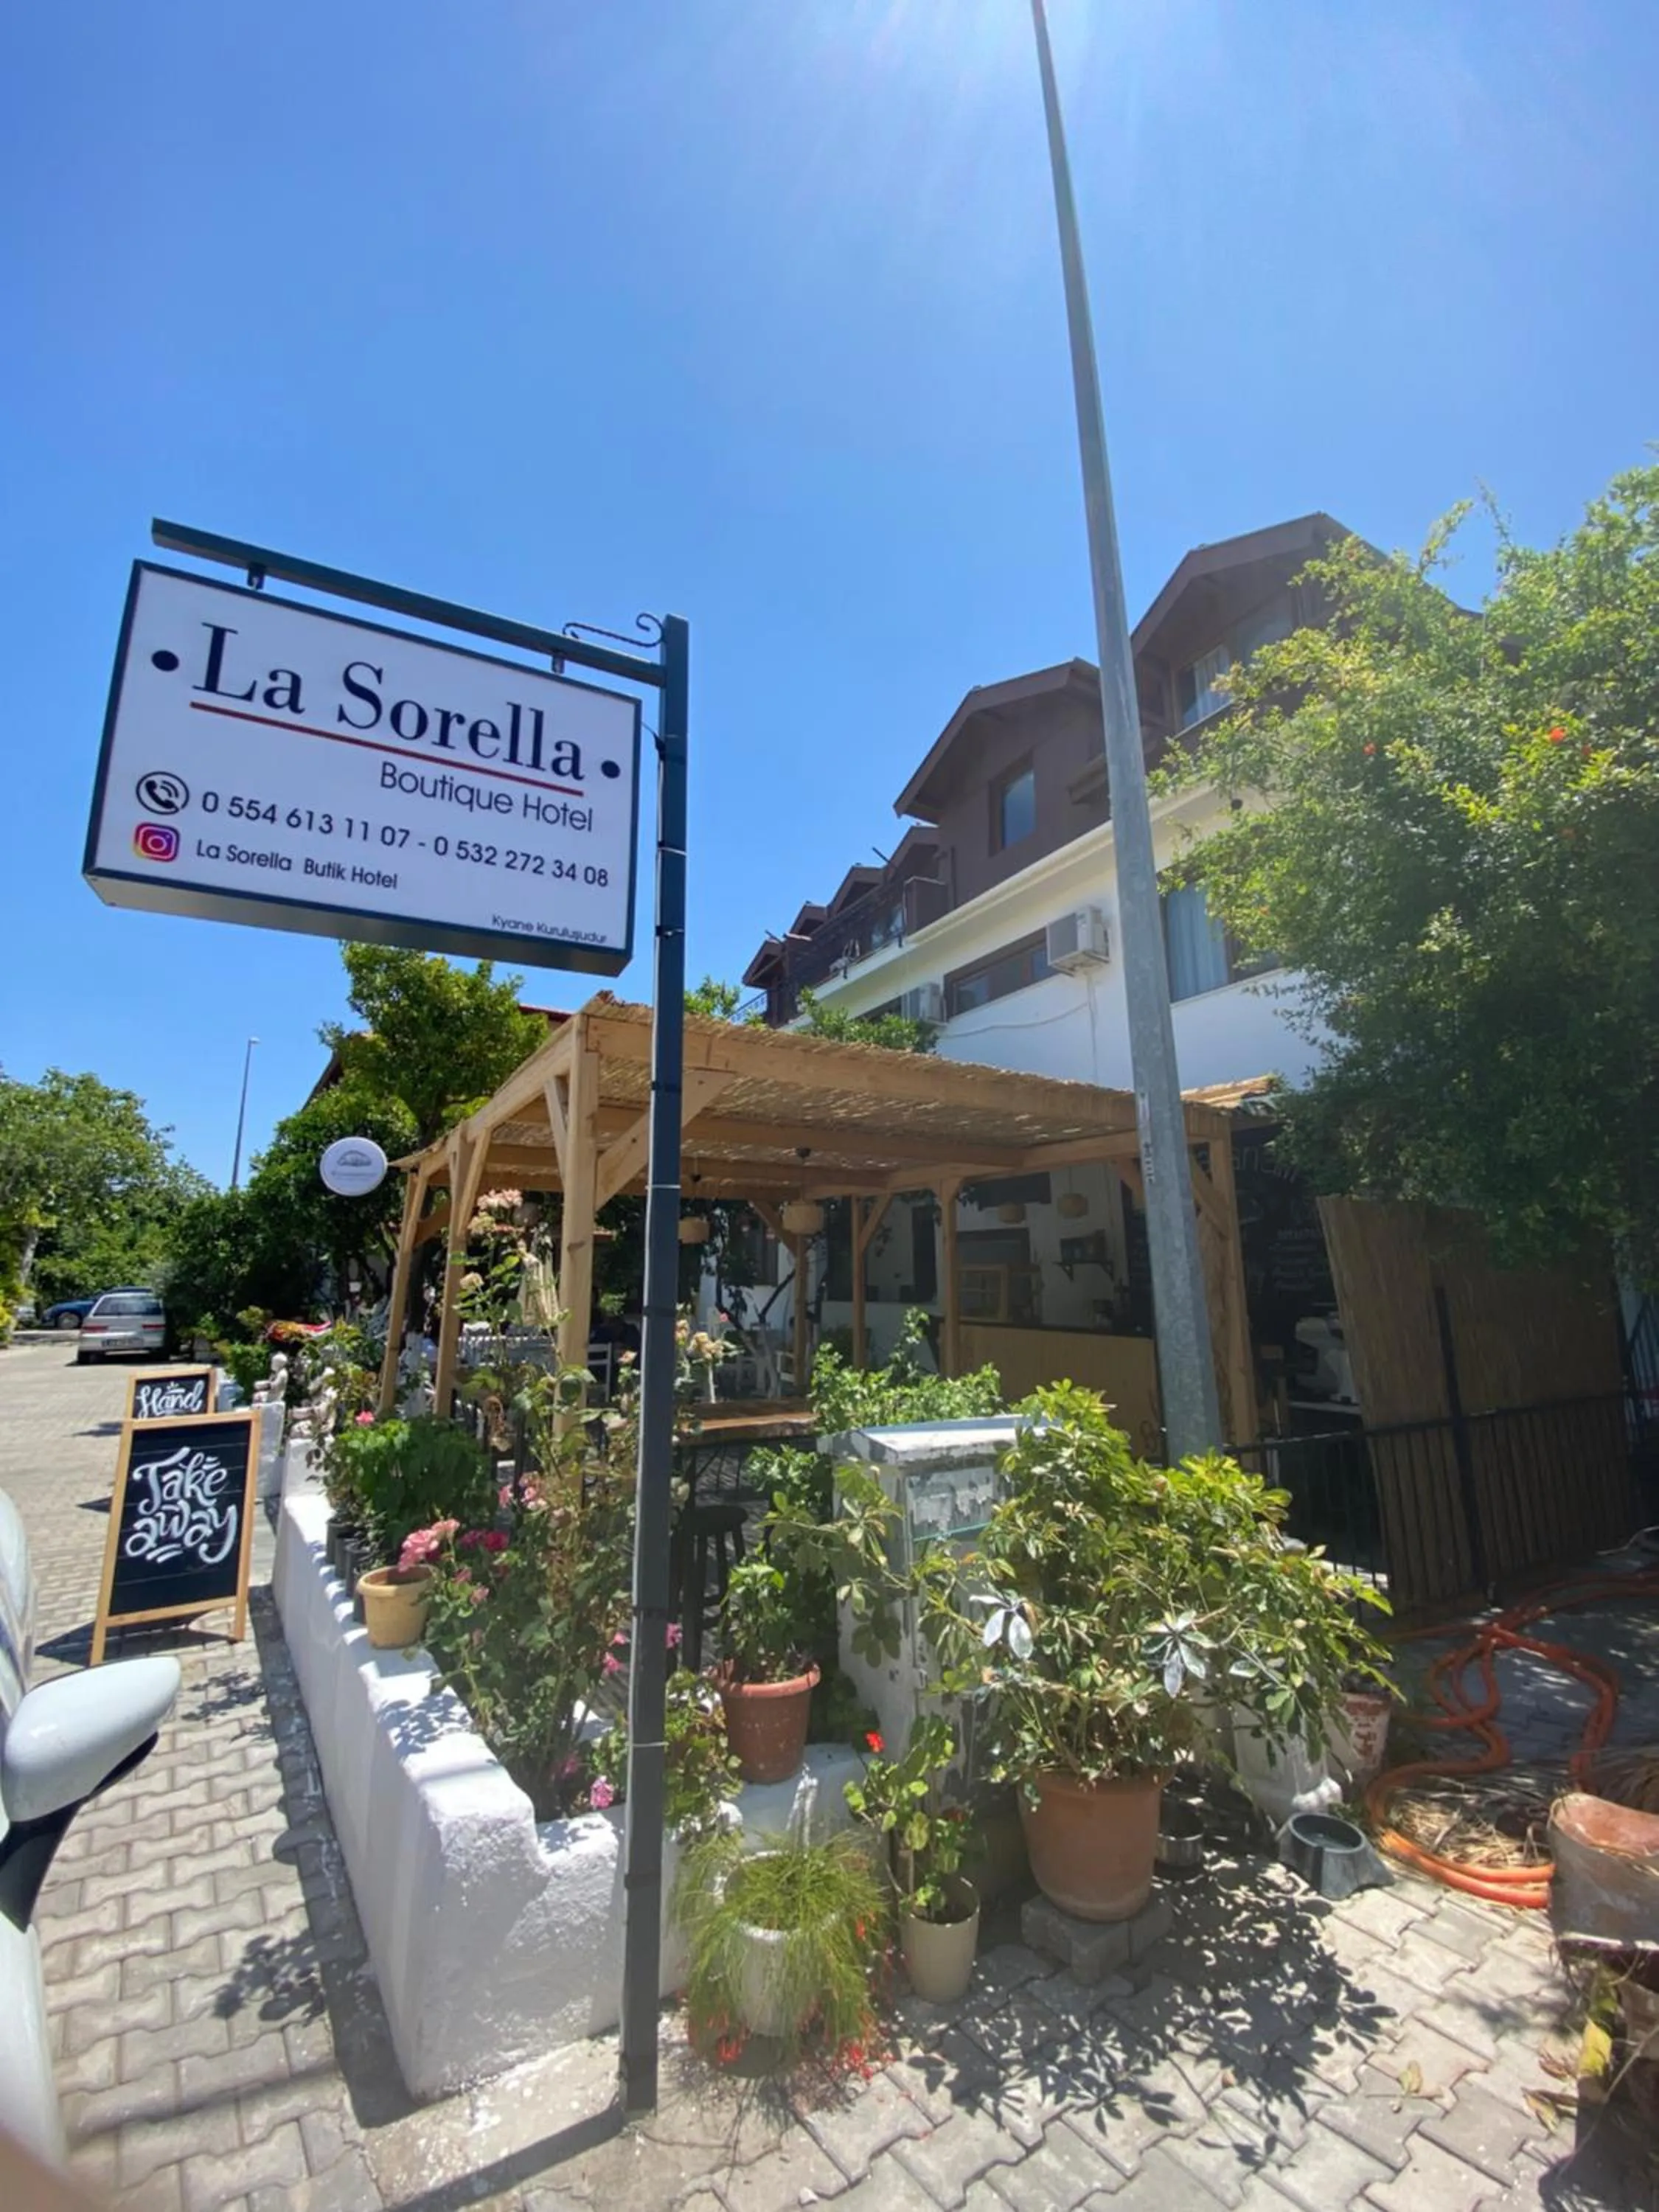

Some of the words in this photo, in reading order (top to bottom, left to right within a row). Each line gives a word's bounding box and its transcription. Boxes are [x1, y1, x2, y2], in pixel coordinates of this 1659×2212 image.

[192, 621, 307, 714] La
[336, 661, 585, 782] Sorella
[380, 760, 514, 813] Boutique
[522, 793, 594, 833] Hotel
[195, 838, 221, 860] La
[226, 844, 293, 872] Sorella
[303, 857, 347, 882] Butik
[350, 866, 398, 890] Hotel
[201, 790, 219, 813] 0
[227, 796, 278, 824] 554
[285, 807, 334, 835] 613
[344, 817, 369, 841] 11
[380, 825, 411, 849] 07
[434, 835, 449, 857] 0
[455, 840, 498, 866] 532
[504, 849, 546, 876] 272
[551, 859, 577, 882] 34
[583, 866, 609, 888] 08
[491, 914, 534, 933] Kyane
[136, 1380, 205, 1419] Hand
[132, 1446, 228, 1515] Take
[125, 1498, 238, 1565] away
